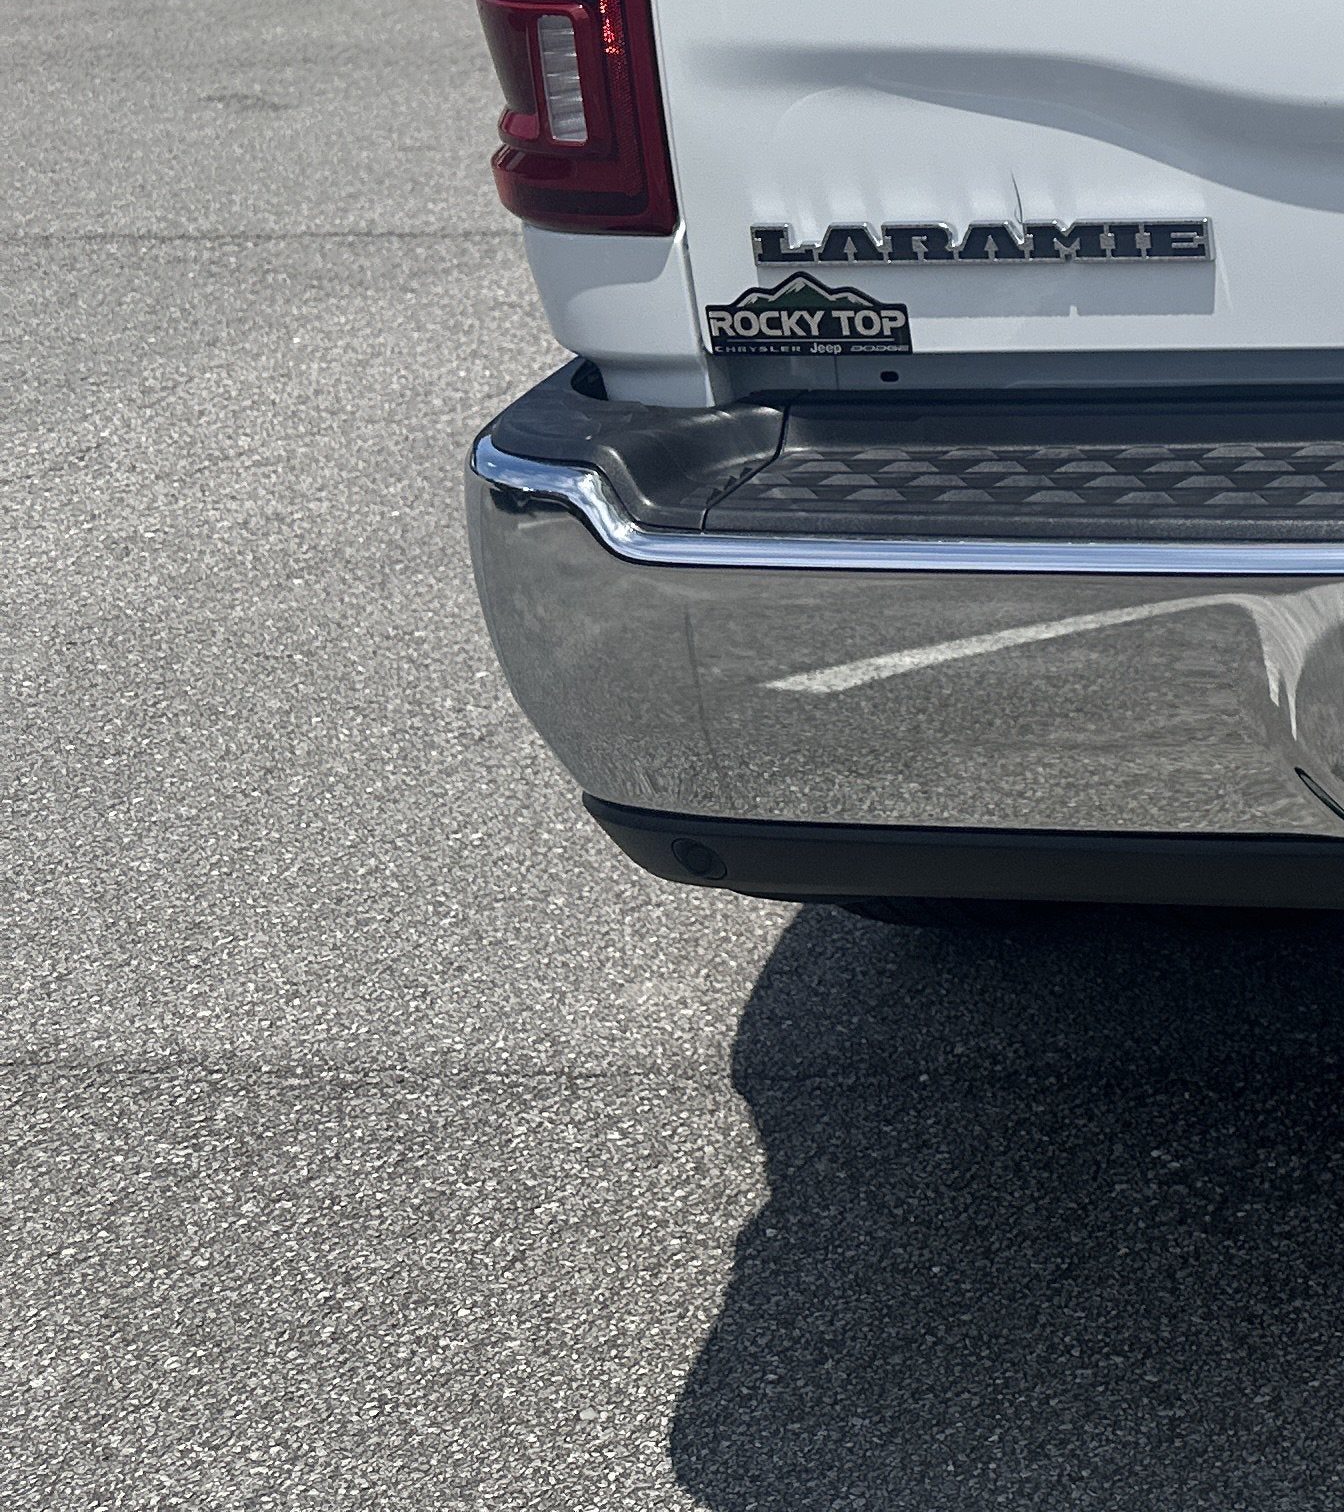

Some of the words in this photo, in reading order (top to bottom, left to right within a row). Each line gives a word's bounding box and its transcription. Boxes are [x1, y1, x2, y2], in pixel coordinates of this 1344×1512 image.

[751, 217, 1215, 266] LARAMIE
[708, 310, 825, 337] ROCKY
[831, 309, 906, 336] TOP
[714, 345, 801, 353] CHRYSLER
[809, 342, 842, 354] Jeep
[850, 344, 909, 352] DODGE
